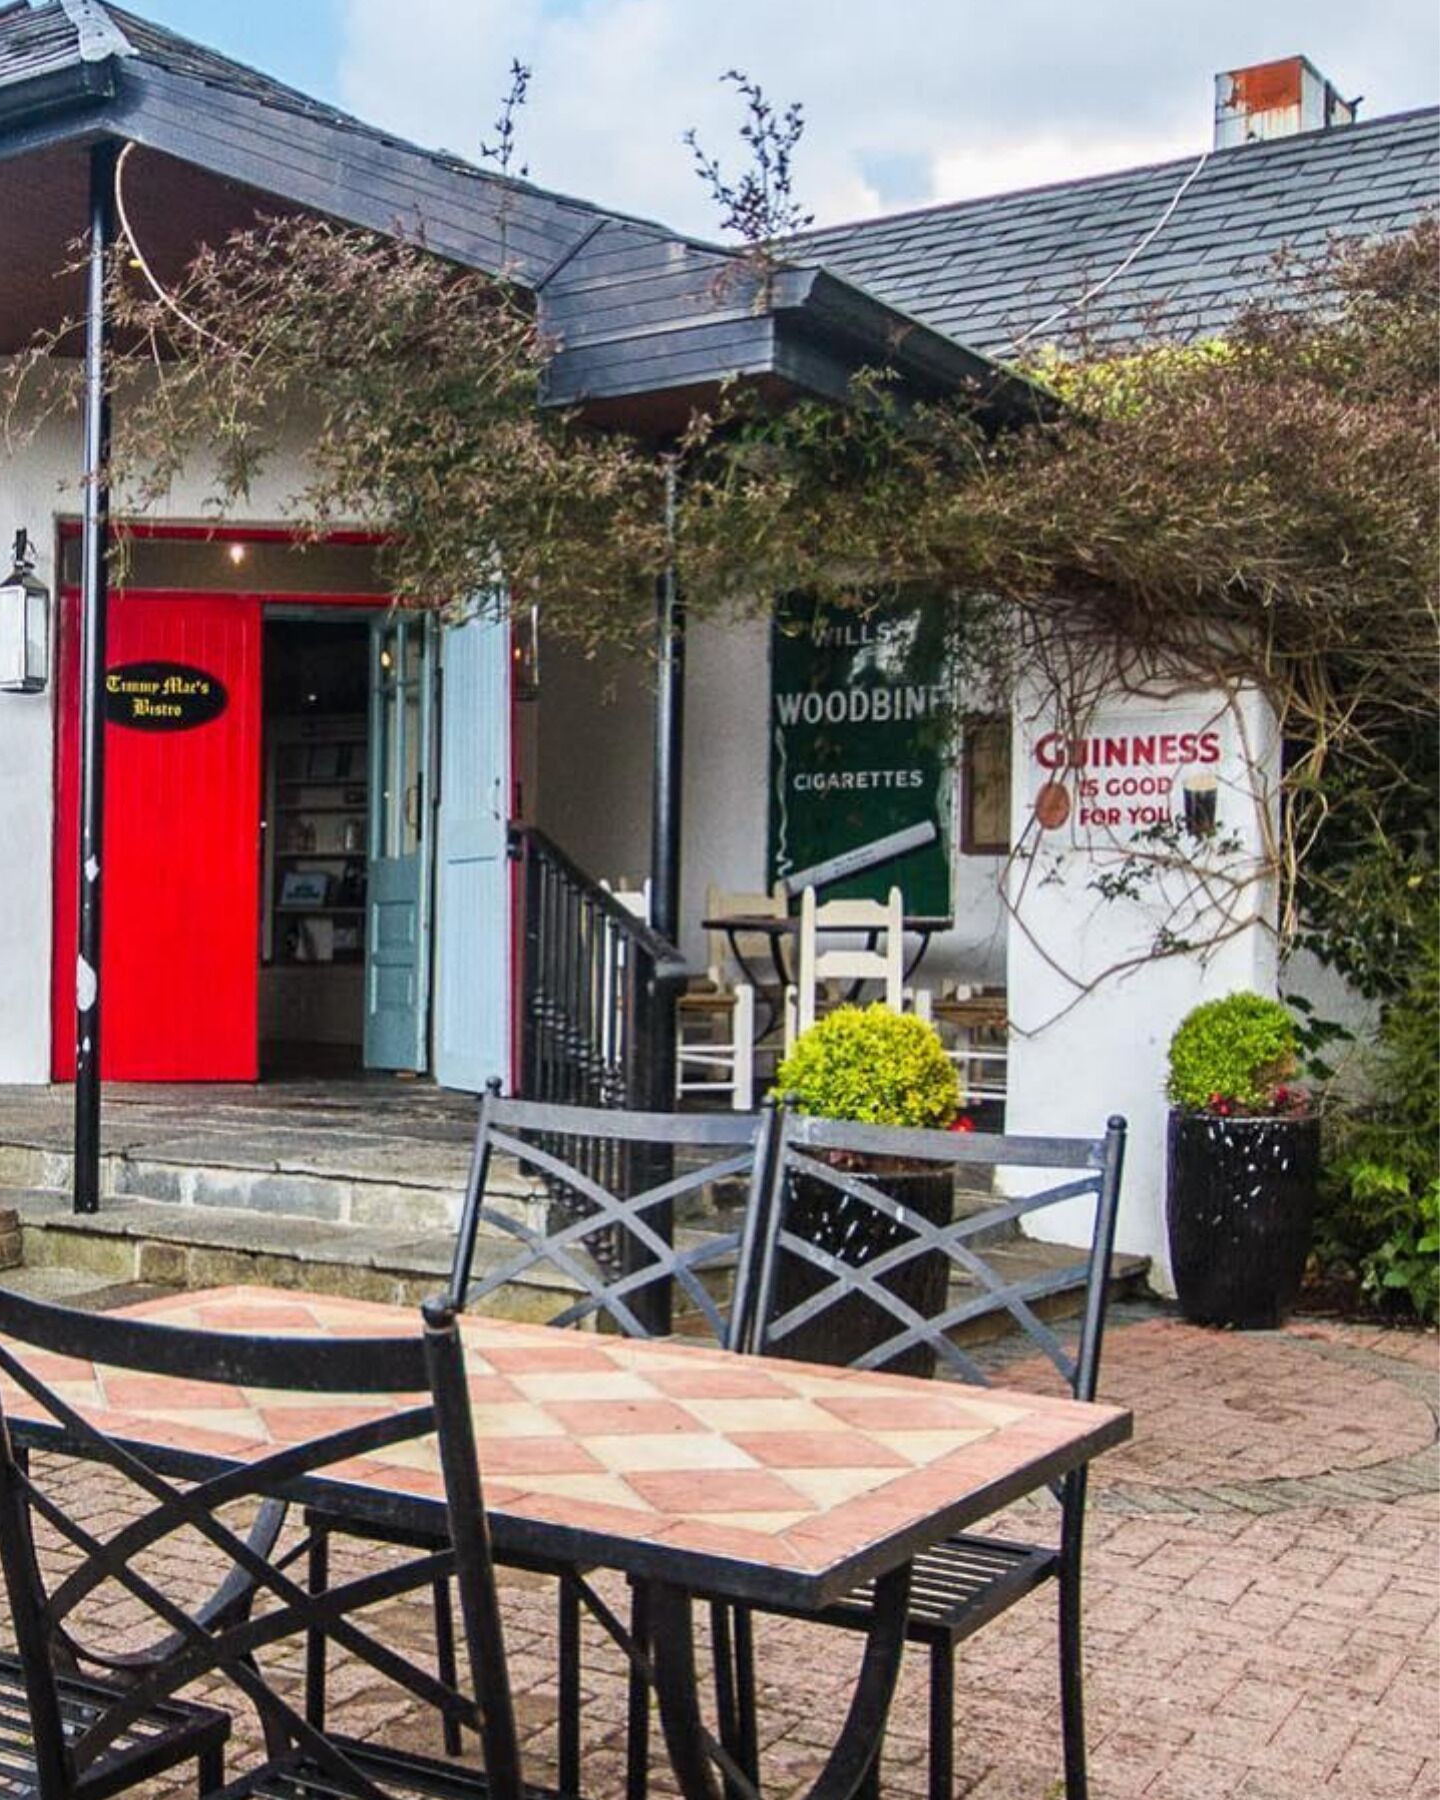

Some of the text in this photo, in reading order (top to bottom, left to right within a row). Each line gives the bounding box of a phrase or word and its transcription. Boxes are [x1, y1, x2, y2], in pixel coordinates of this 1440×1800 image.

[162, 676, 209, 695] Mac's
[133, 698, 182, 717] Bistro
[1034, 730, 1221, 769] GUINNESS
[793, 769, 924, 791] CIGARETTES
[1079, 776, 1173, 797] IS GOOD
[1079, 805, 1173, 827] FOR YOU
